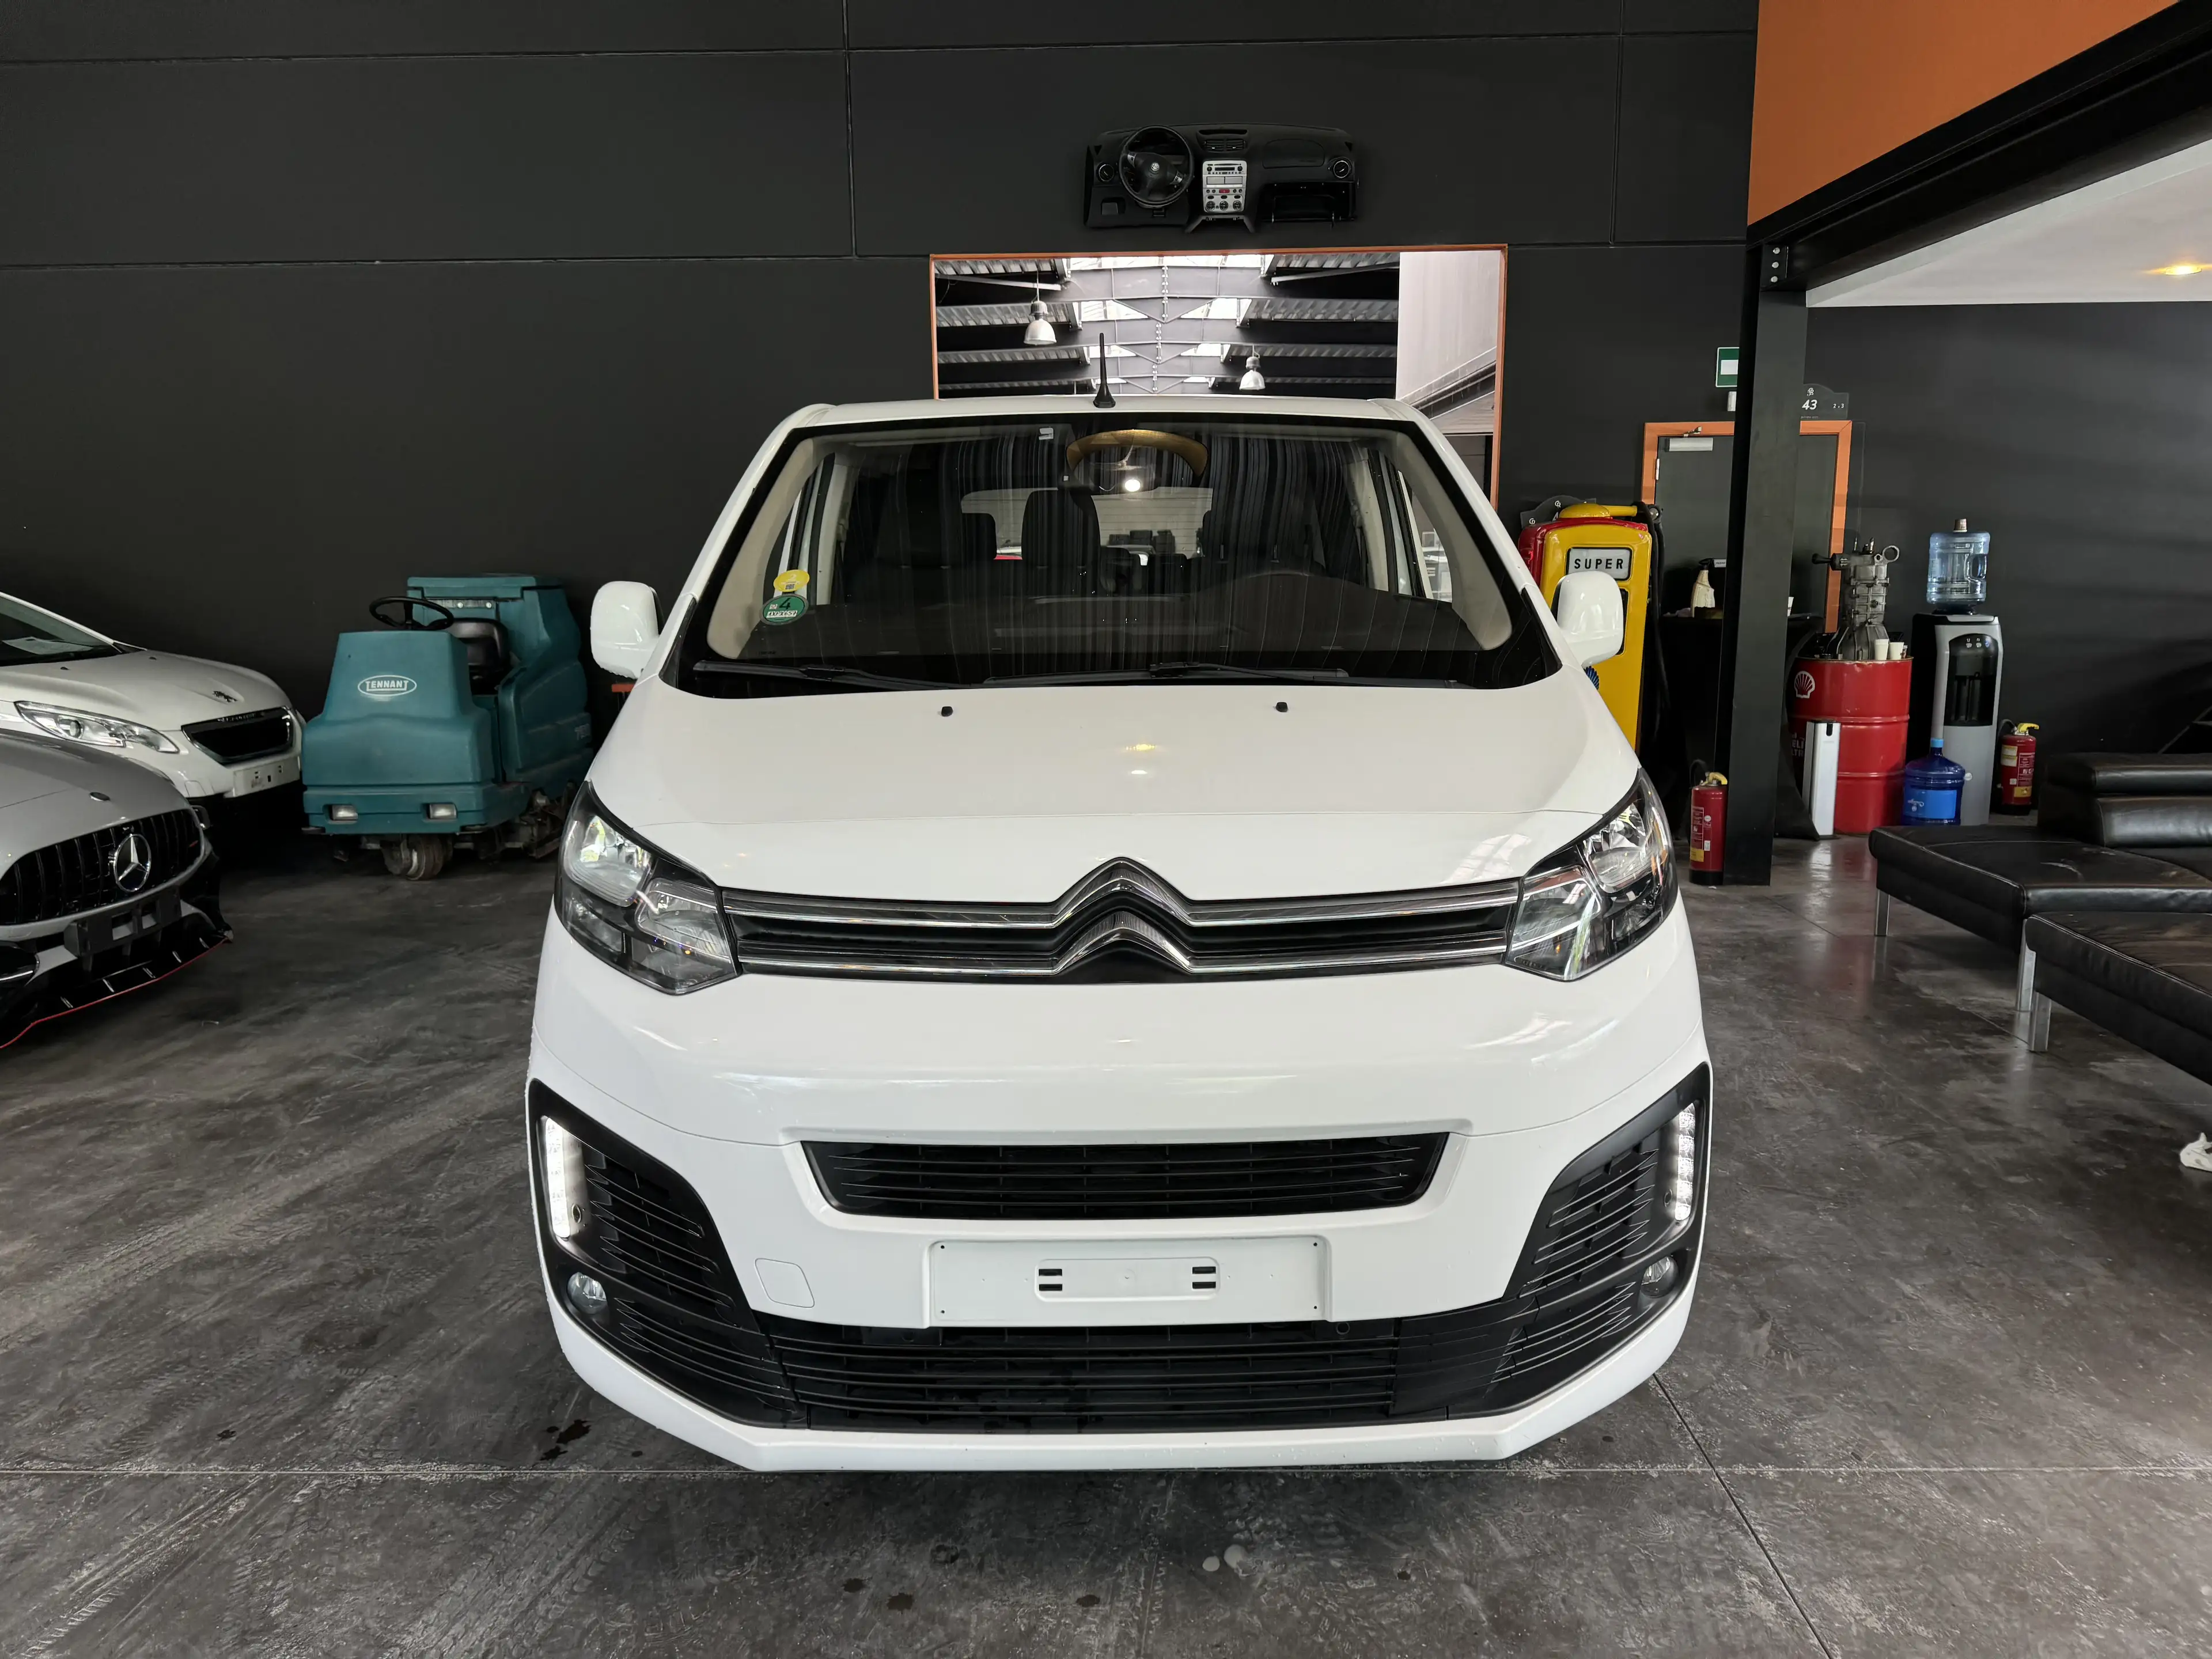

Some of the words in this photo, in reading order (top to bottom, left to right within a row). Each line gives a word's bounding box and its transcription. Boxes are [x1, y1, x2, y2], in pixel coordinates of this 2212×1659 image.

[1802, 399, 1817, 410] 43
[1574, 558, 1623, 569] SUPER
[779, 597, 791, 609] 4
[365, 680, 409, 692] TENNANT
